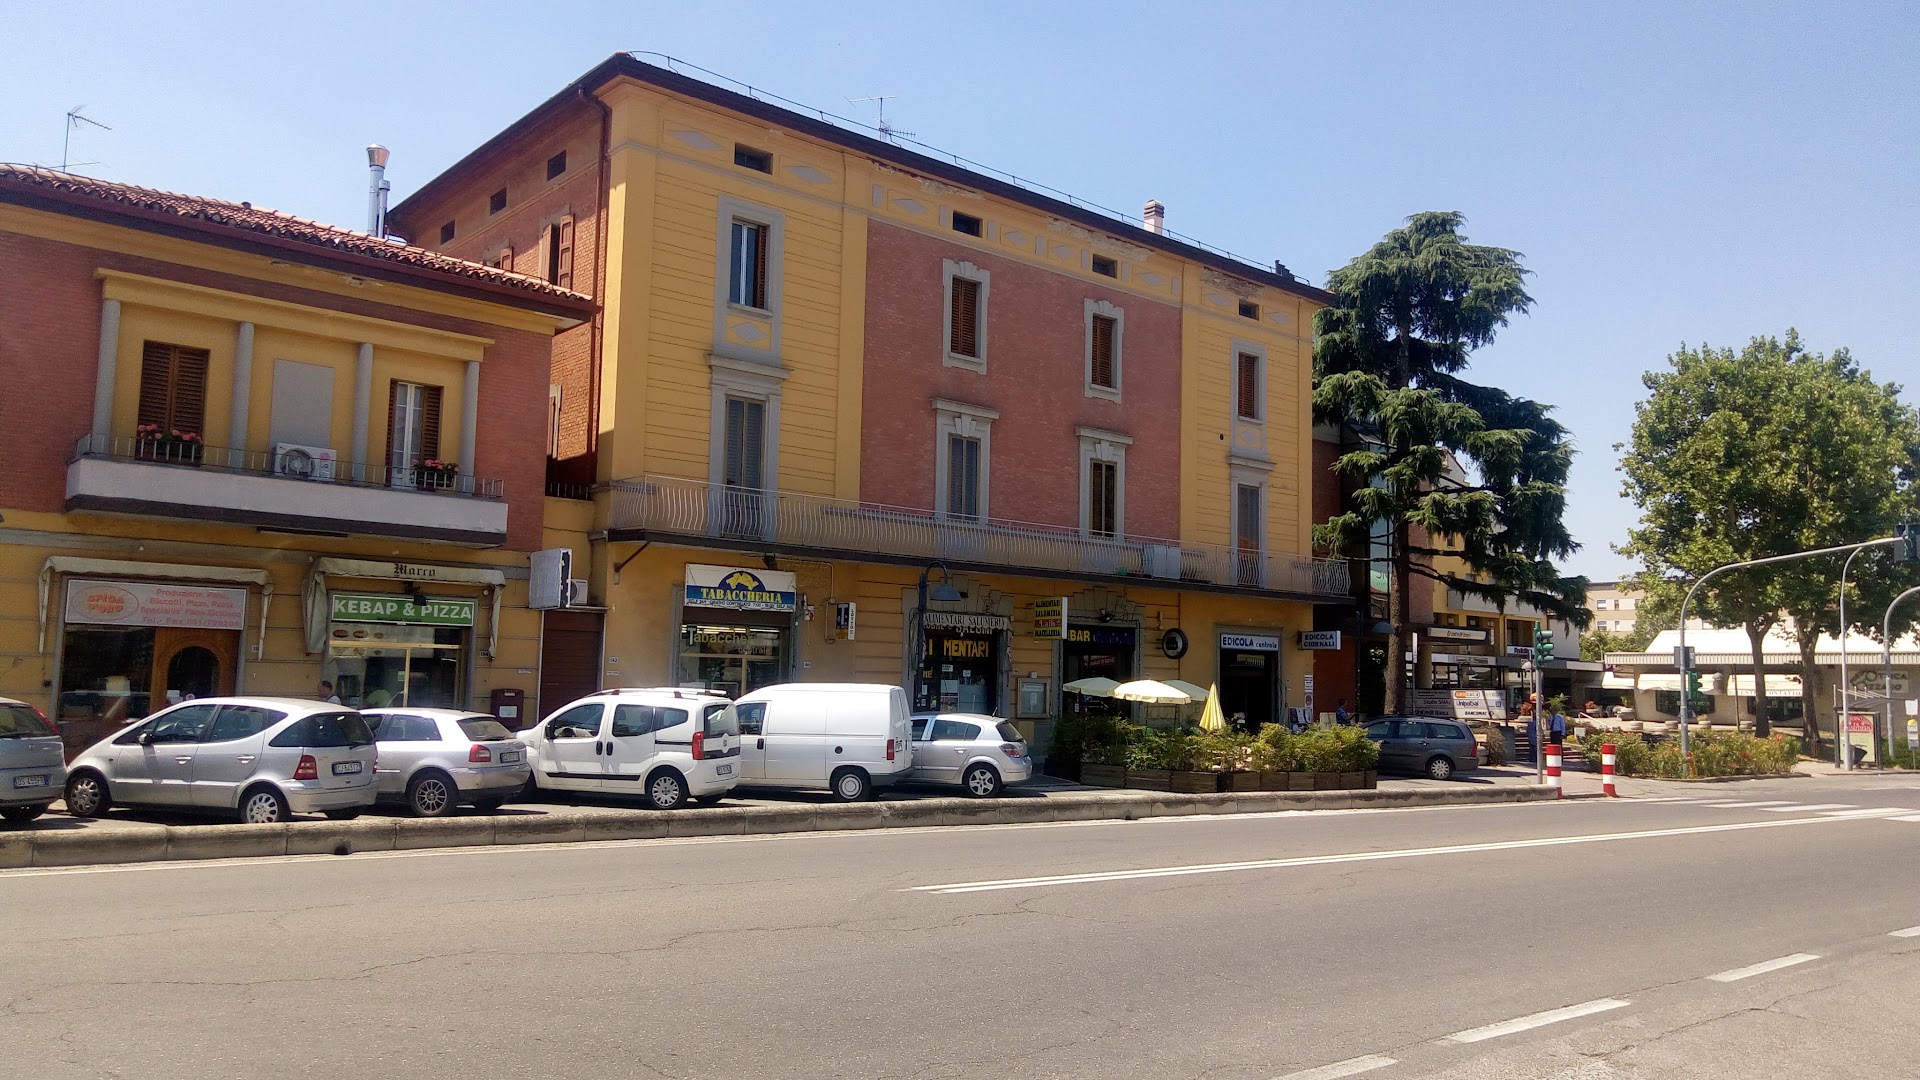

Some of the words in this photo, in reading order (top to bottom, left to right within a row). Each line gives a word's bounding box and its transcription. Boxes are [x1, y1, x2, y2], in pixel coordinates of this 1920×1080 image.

[393, 562, 436, 577] Marco
[700, 588, 782, 604] TABACCHERIA
[335, 600, 398, 616] KEBAP
[402, 602, 415, 617] &
[420, 604, 472, 619] PIZZA
[1069, 629, 1091, 642] BAR
[1222, 636, 1254, 647] EDICOLA
[1304, 633, 1334, 641] EDICOLA
